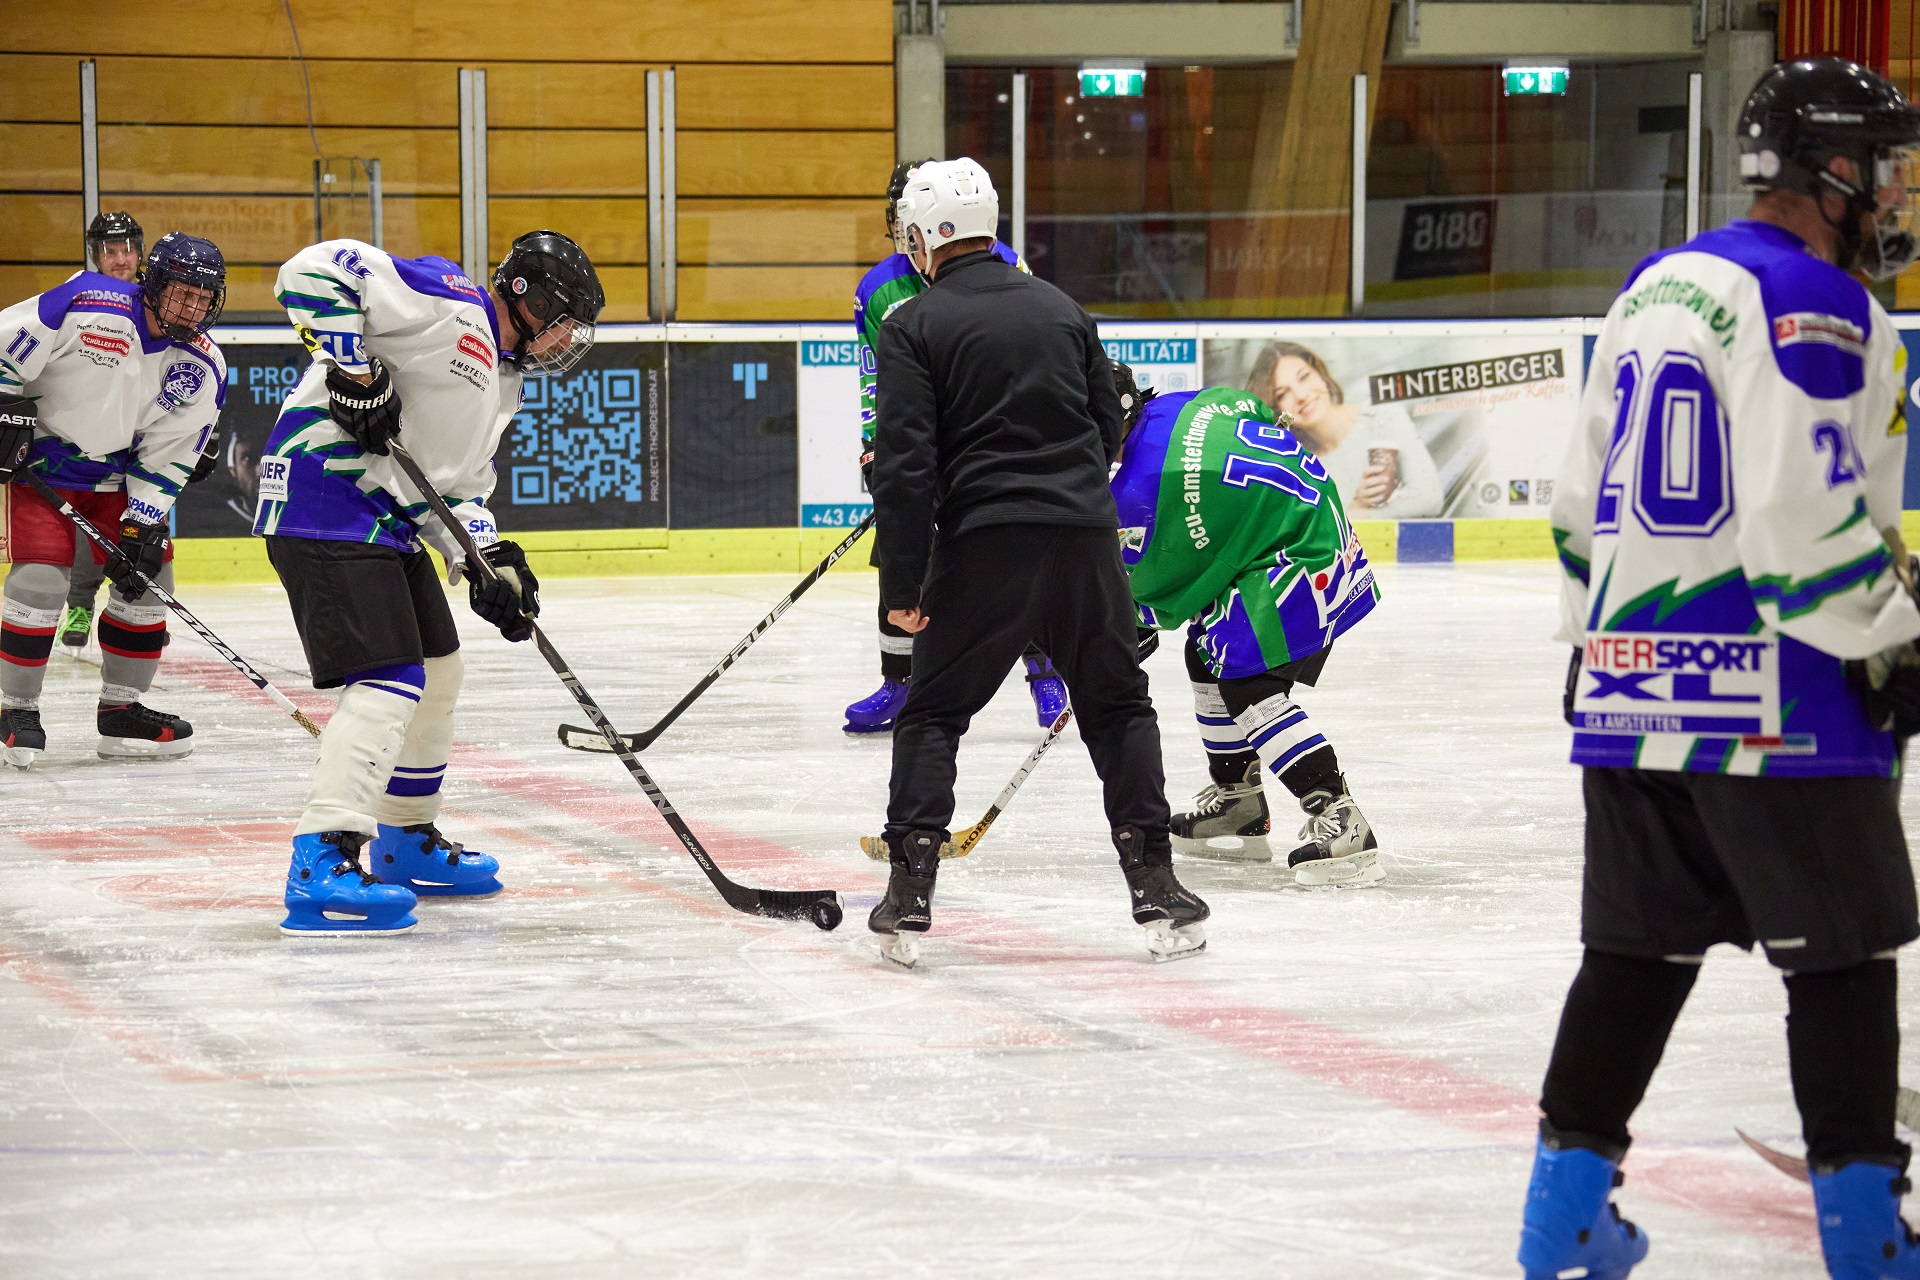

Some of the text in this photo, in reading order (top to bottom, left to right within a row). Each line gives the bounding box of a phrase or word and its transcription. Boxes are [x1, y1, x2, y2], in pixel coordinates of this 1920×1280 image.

[196, 266, 218, 276] CCM
[6, 326, 41, 366] 11
[1102, 340, 1189, 361] BILITÄT!
[1592, 349, 1734, 537] 20
[72, 516, 101, 541] USA
[811, 508, 845, 526] +43
[708, 594, 795, 677] TRUE
[1585, 638, 1769, 671] NTERSPORT
[1584, 671, 1762, 704] XL
[680, 832, 712, 871] SYNERGY
